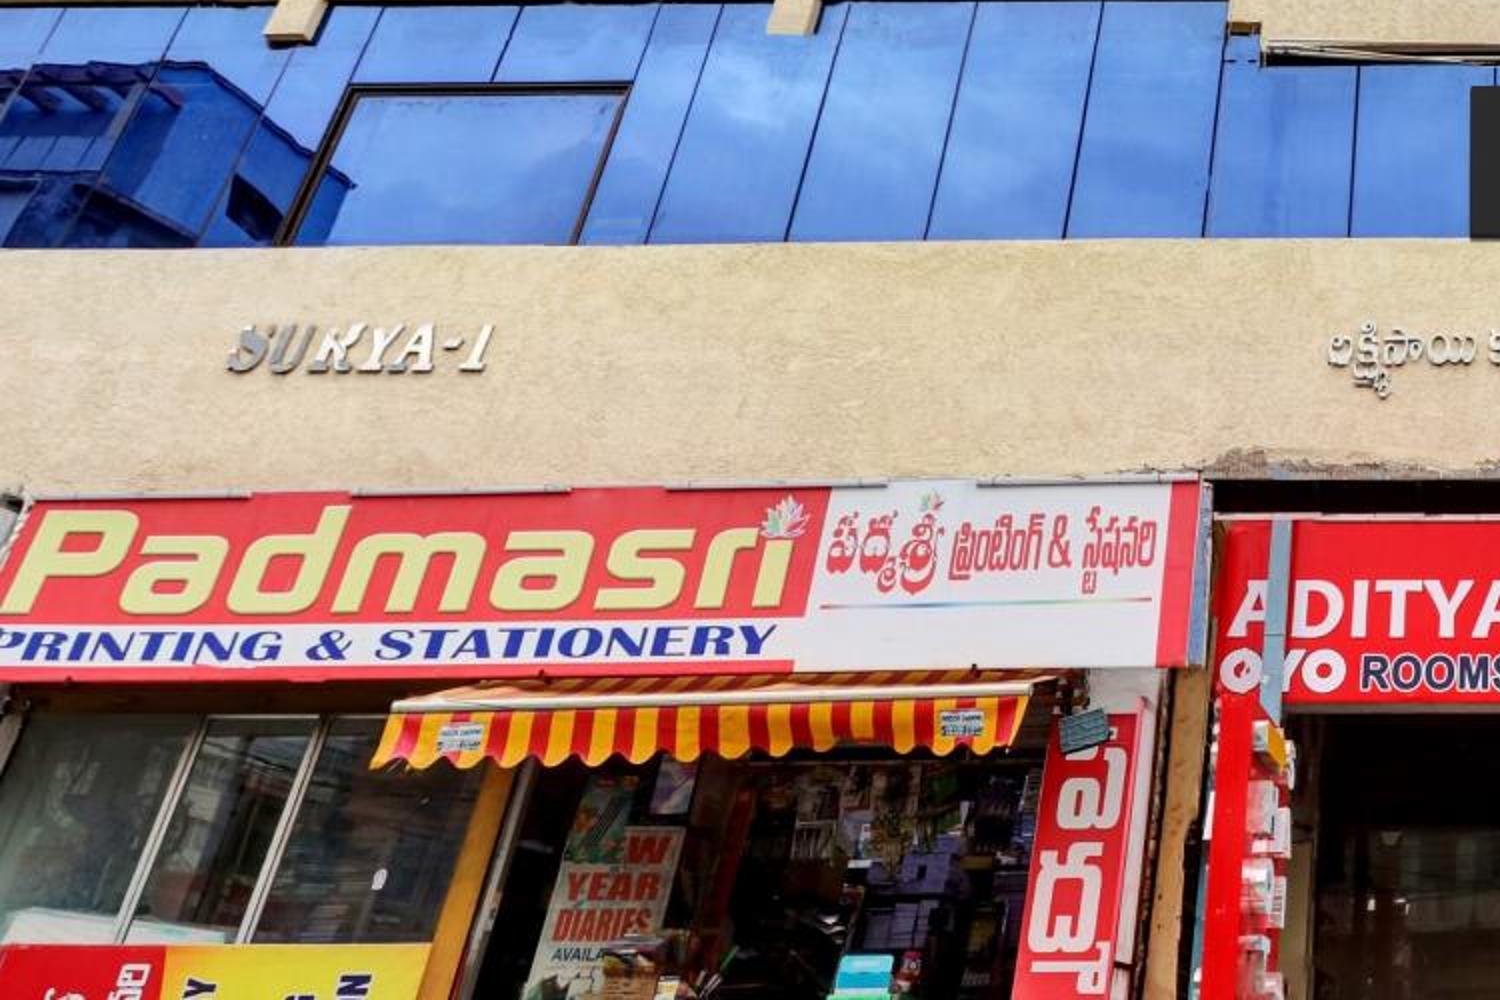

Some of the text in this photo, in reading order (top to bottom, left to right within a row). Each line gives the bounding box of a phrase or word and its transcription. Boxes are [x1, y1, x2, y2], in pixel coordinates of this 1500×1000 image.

[1047, 513, 1072, 569] &
[0, 504, 797, 616] Padmasri
[306, 627, 354, 661] &
[374, 624, 778, 661] STATIONERY
[567, 871, 661, 901] YEAR
[552, 908, 652, 943] DIARIES
